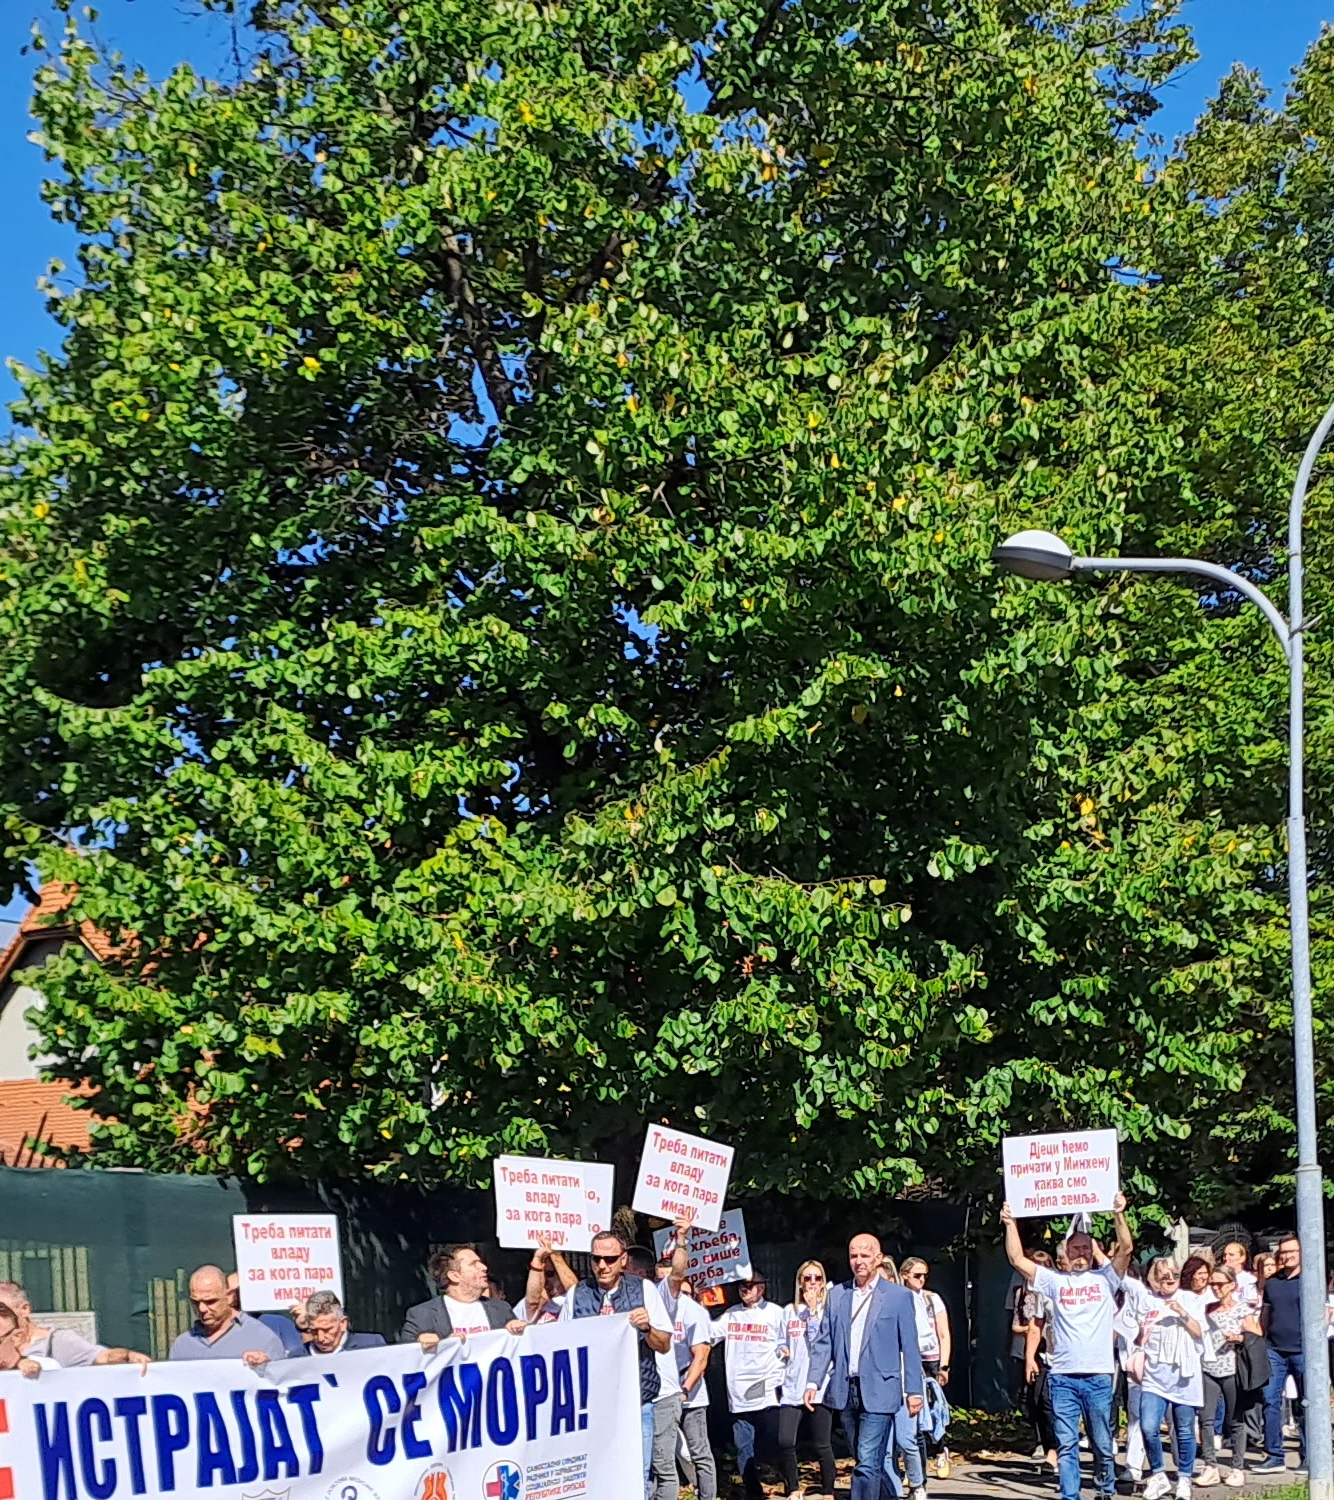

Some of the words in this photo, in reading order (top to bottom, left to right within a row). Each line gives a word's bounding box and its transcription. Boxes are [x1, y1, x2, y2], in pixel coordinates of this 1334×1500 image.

[653, 1131, 689, 1157] Треба
[690, 1146, 728, 1168] питати
[1030, 1141, 1059, 1160] Дјеци
[1062, 1140, 1089, 1154] ћемо
[669, 1161, 704, 1183] владу
[1010, 1161, 1052, 1178] причати
[1055, 1160, 1061, 1175] у
[1063, 1156, 1111, 1171] Минхену
[500, 1166, 538, 1187] Треба
[541, 1174, 580, 1189] питати
[1034, 1178, 1064, 1190] каква
[1067, 1176, 1088, 1188] смо
[525, 1190, 561, 1209] владу
[646, 1174, 661, 1189] за
[664, 1179, 689, 1197] кога
[692, 1188, 718, 1205] пара
[1024, 1193, 1058, 1211] лијепа
[506, 1210, 521, 1221] за
[524, 1210, 552, 1223] кога
[554, 1213, 582, 1228] пара
[241, 1222, 285, 1243] Треба
[288, 1225, 332, 1240] питати
[271, 1246, 310, 1263] владу
[248, 1268, 265, 1281] за
[270, 1267, 301, 1281] кога
[304, 1266, 334, 1284] пара
[363, 1370, 434, 1466] СЕ
[436, 1345, 589, 1454] МОРА!
